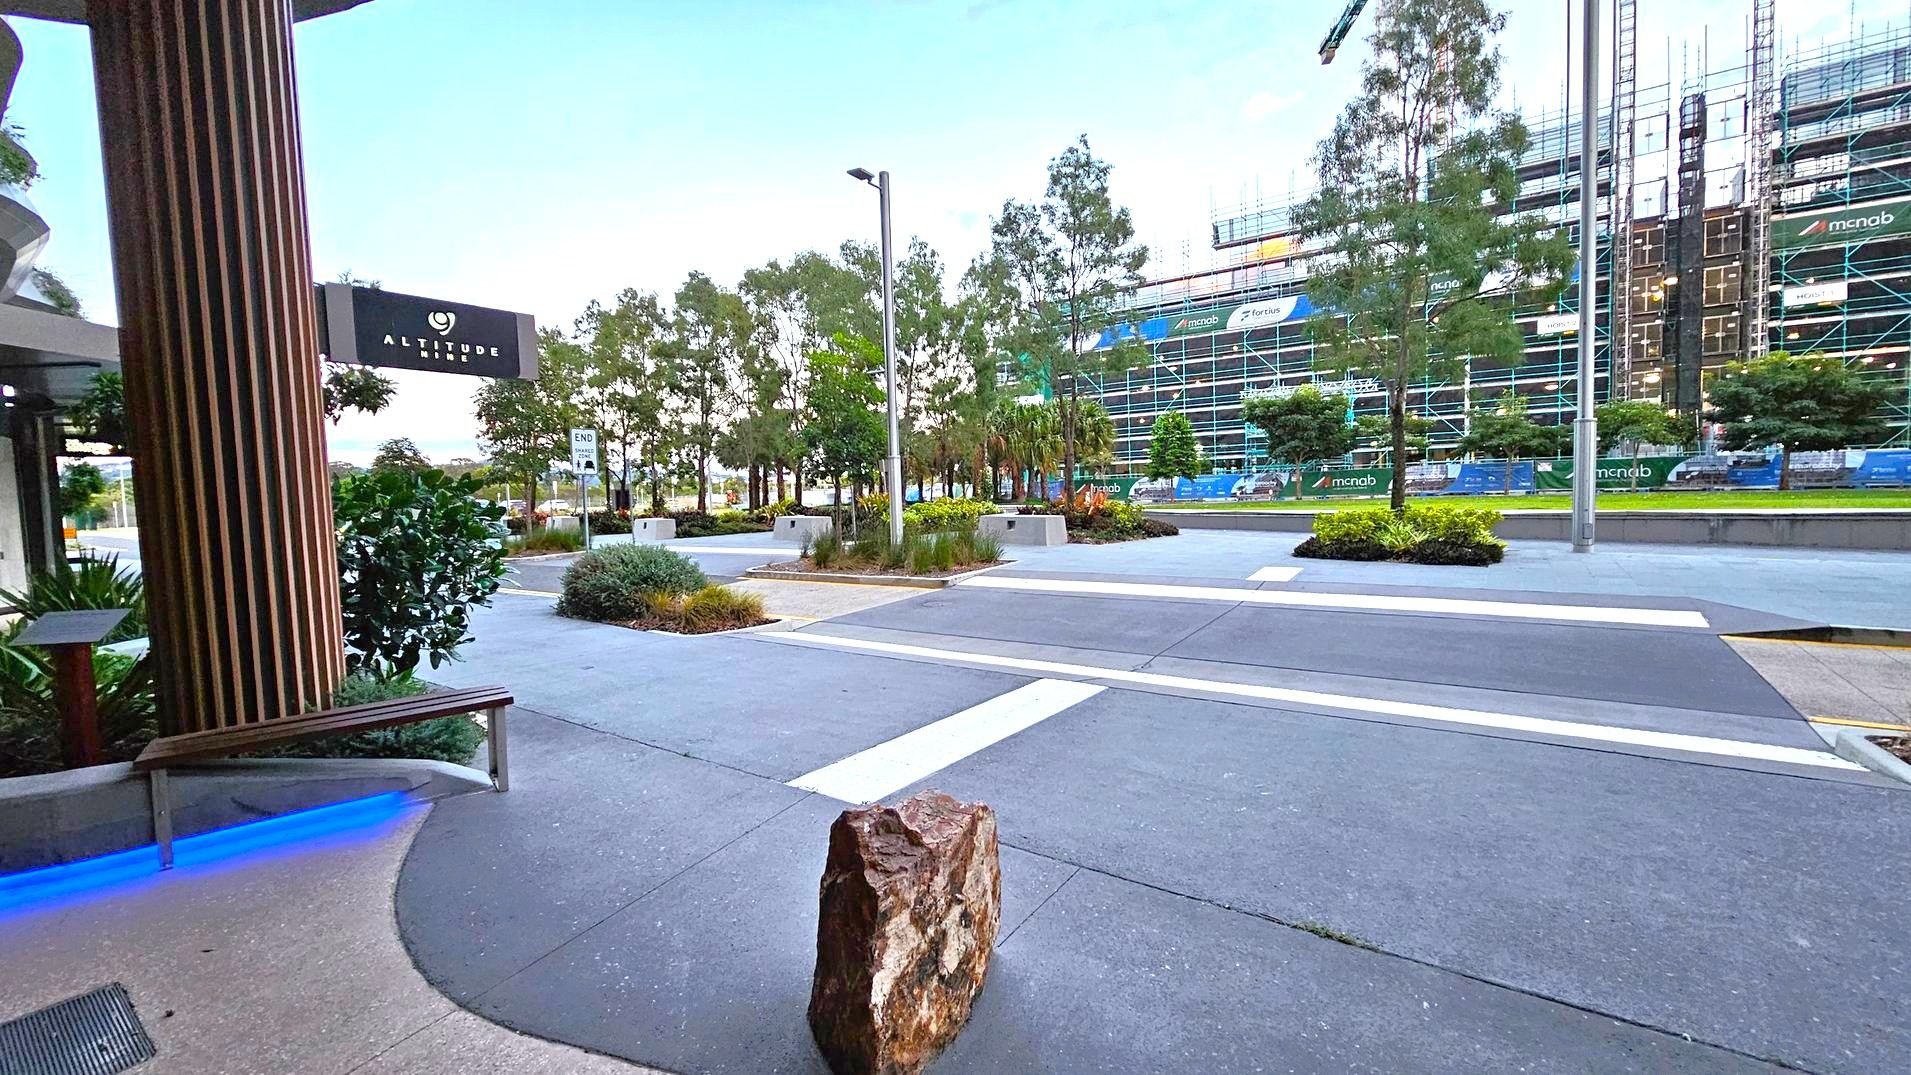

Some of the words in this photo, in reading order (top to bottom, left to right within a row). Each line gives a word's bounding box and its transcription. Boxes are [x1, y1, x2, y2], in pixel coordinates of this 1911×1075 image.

[1829, 211, 1894, 231] mcnab
[1796, 291, 1825, 299] HOIST
[1252, 307, 1280, 317] fortius
[1188, 315, 1219, 327] mcnab
[383, 334, 499, 357] ALTITUDE
[420, 350, 468, 362] NINE
[574, 433, 593, 443] END
[1332, 474, 1377, 487] mcnab
